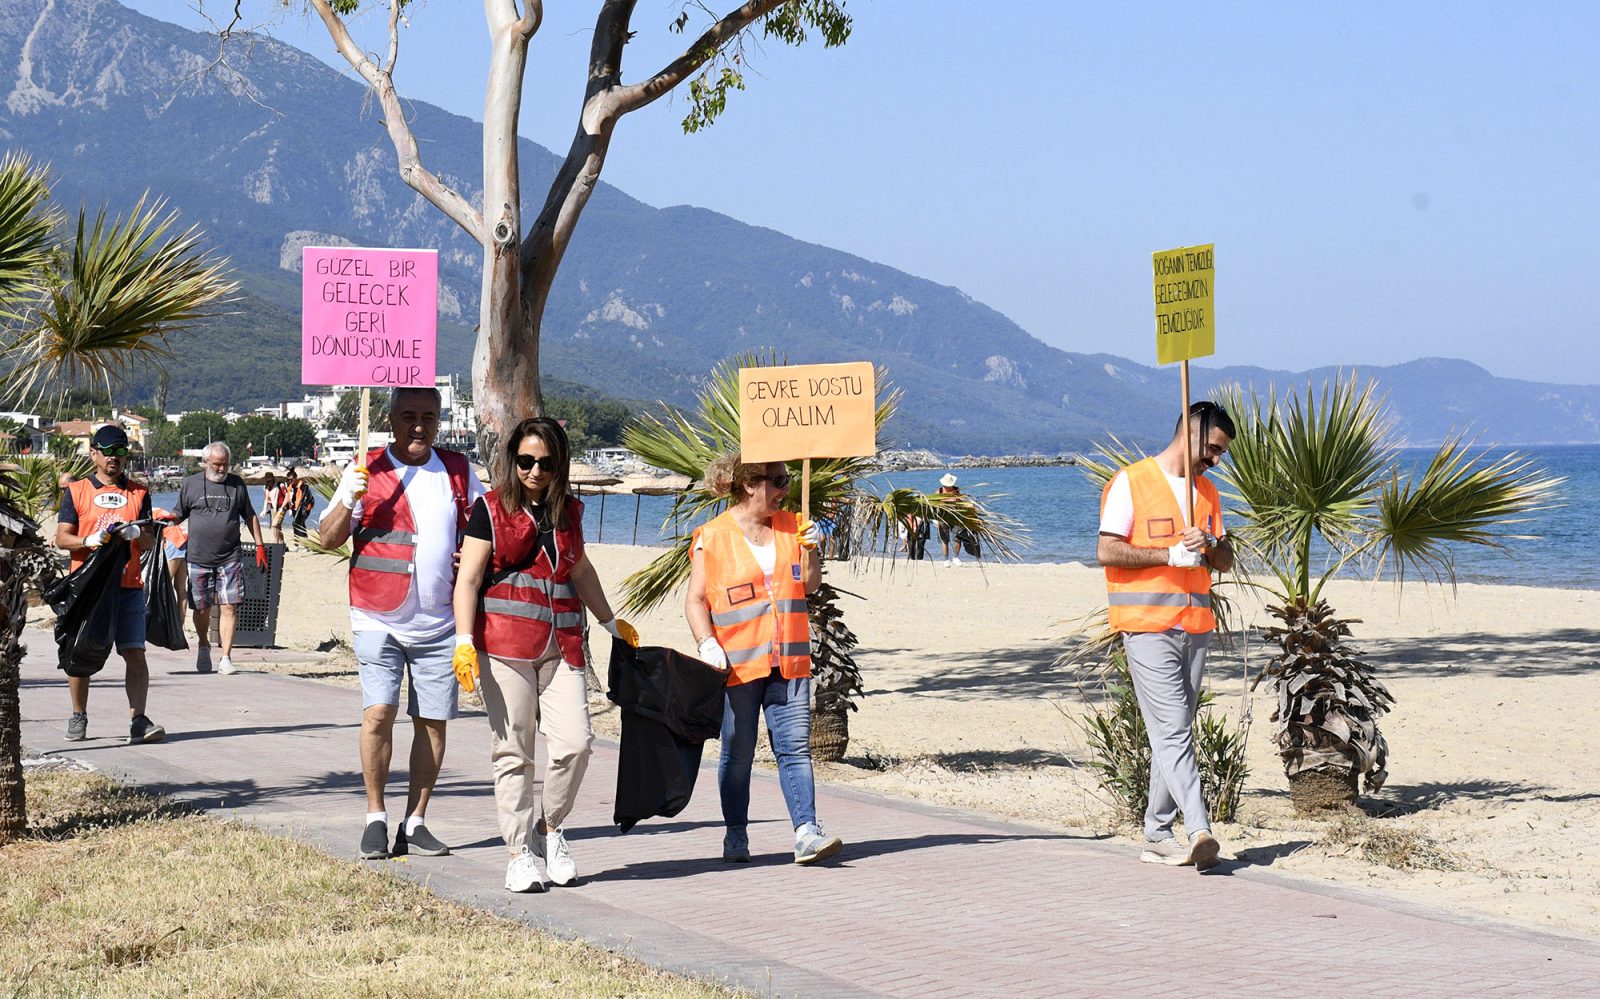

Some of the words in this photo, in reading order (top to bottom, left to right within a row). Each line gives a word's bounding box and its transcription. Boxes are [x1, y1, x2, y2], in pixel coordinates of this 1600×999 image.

[317, 258, 373, 276] GÜZEL
[390, 259, 416, 278] BİR
[323, 282, 409, 306] GELECEK
[346, 311, 385, 333] GERİ
[312, 335, 422, 359] DÖNÜŞÜMLE
[747, 379, 800, 403] ÇEVRE
[809, 376, 863, 397] DOSTU
[763, 405, 835, 428] OLALIM
